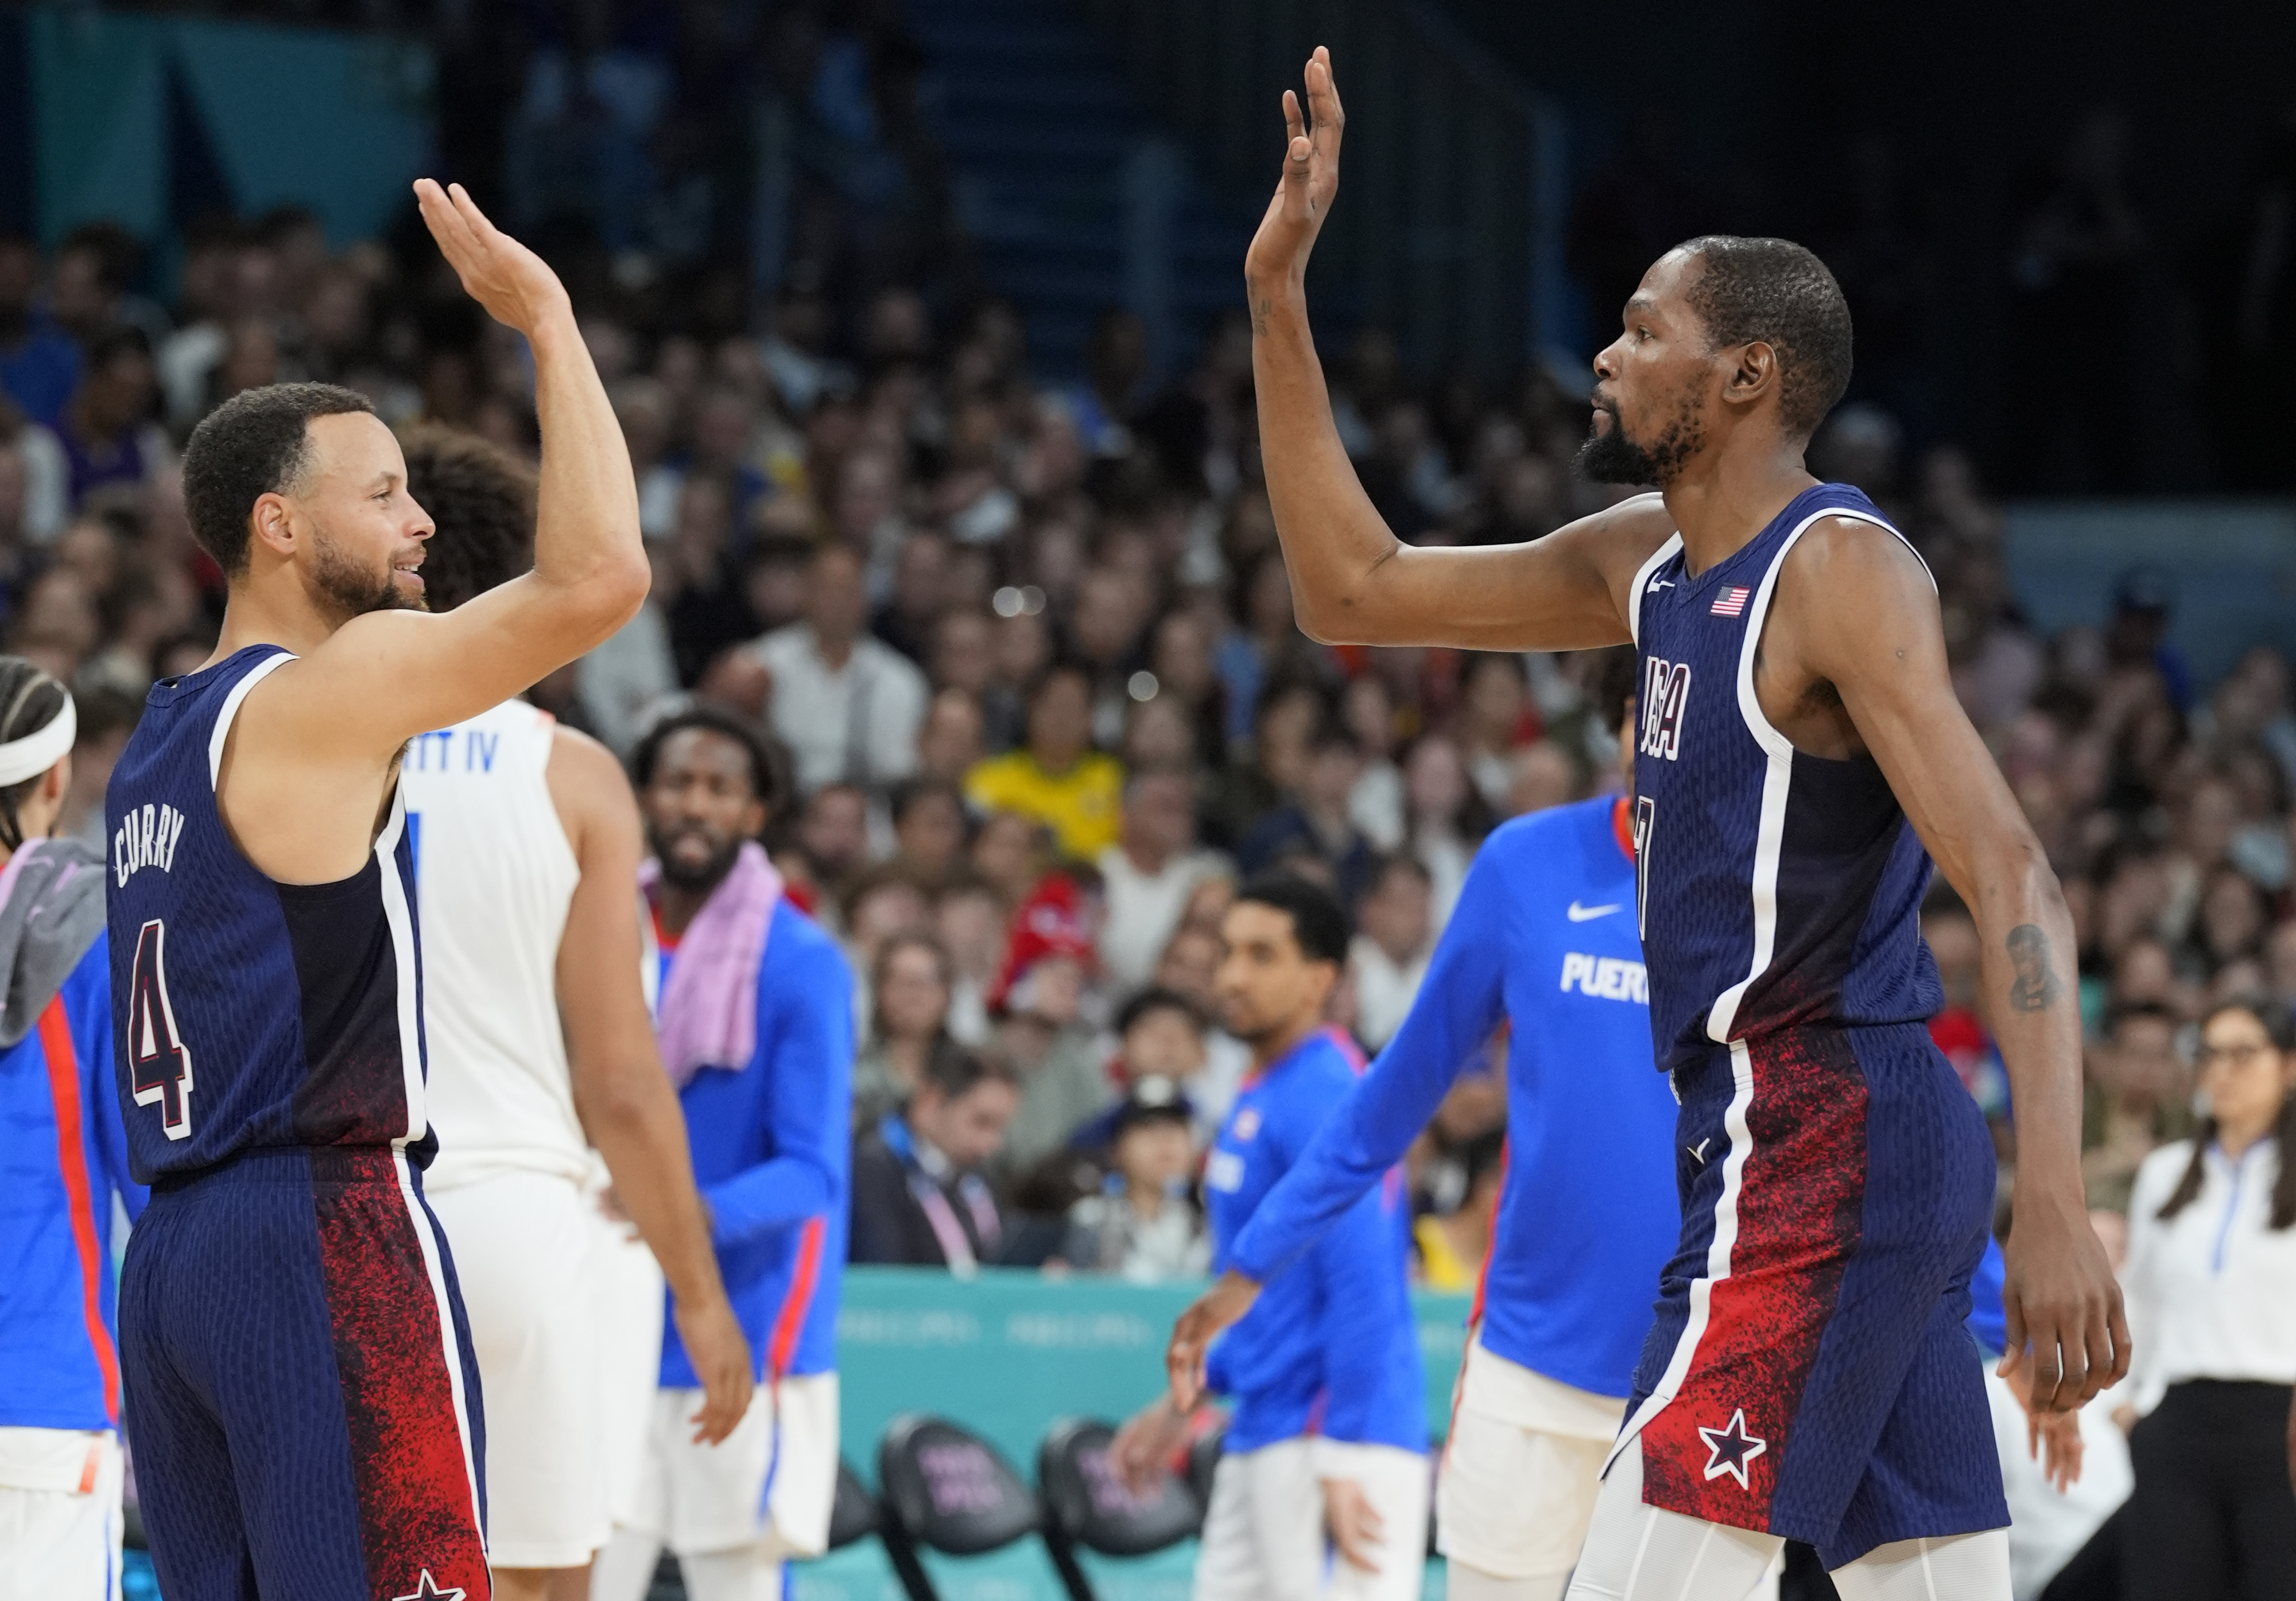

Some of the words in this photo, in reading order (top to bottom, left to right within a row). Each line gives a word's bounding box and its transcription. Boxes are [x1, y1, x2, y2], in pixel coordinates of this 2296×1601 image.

[468, 730, 499, 772] IV
[1640, 655, 1691, 761] USA
[115, 803, 185, 888] CURRY
[129, 919, 193, 1141] 4
